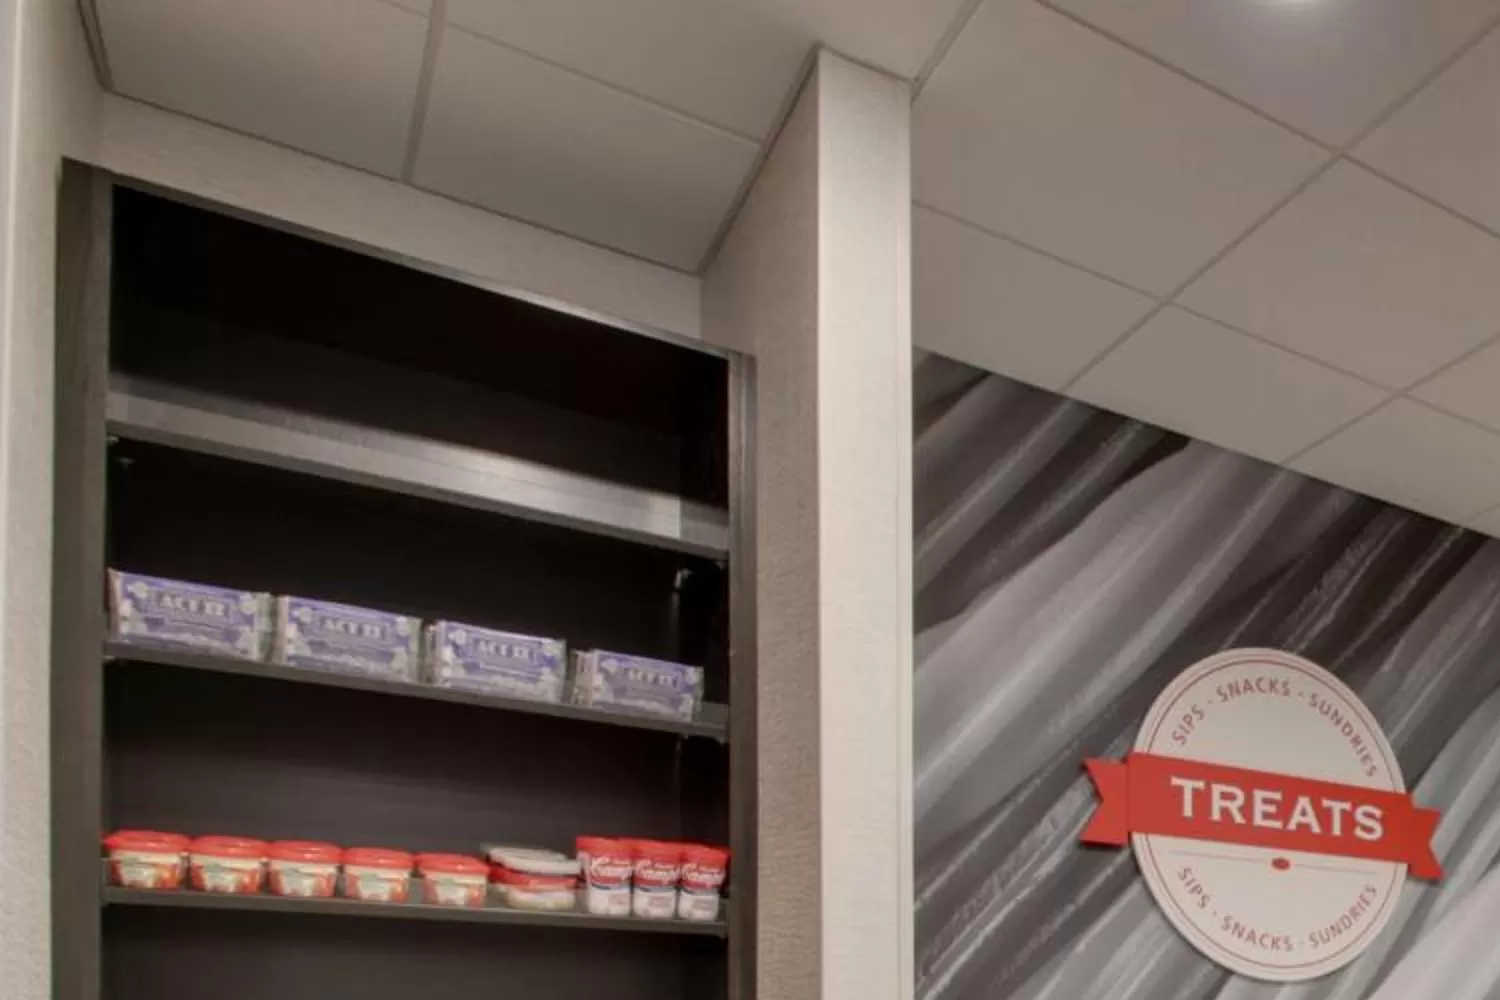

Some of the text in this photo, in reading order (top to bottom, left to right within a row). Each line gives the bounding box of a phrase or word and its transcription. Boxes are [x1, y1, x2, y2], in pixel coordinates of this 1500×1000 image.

[1171, 676, 1378, 778] SIPS SNACKS SUNDRIES
[1170, 776, 1384, 842] TREATS
[1177, 867, 1378, 952] SIPS SNACKS SUNDRIES
